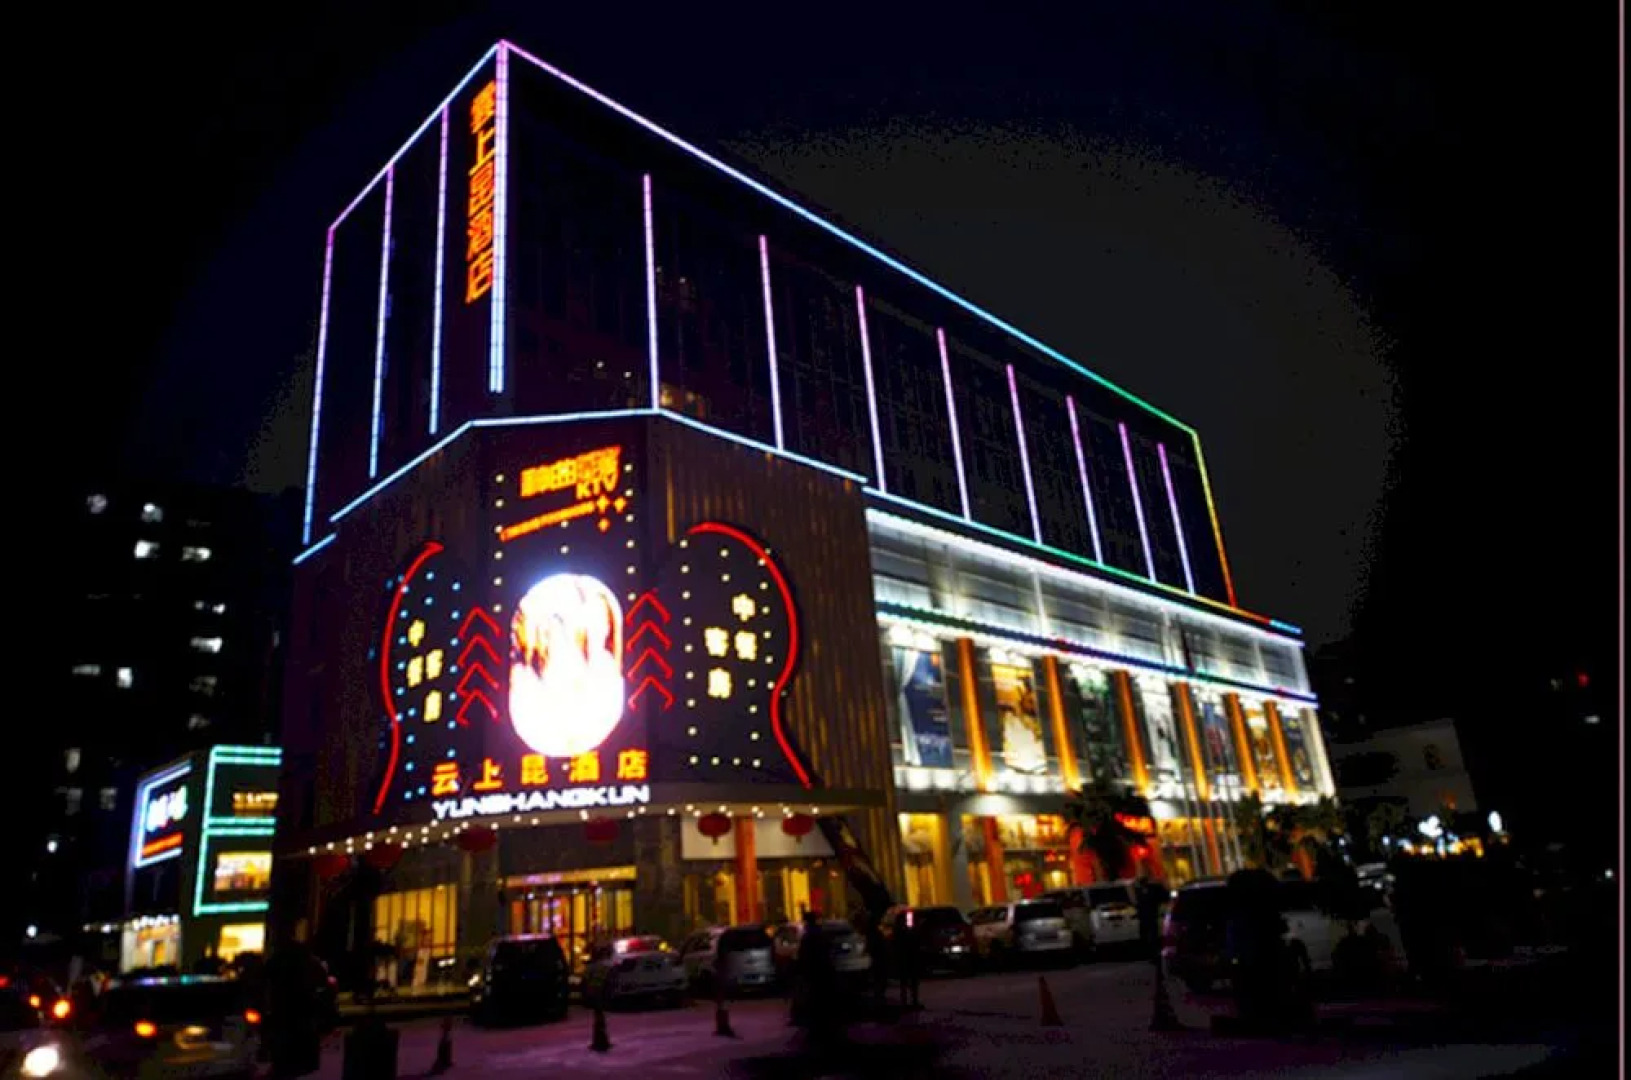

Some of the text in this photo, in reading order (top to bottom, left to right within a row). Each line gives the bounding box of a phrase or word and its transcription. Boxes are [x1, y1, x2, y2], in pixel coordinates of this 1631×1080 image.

[575, 472, 619, 499] KTV
[431, 749, 649, 796] 云上昆酒店
[431, 785, 650, 820] YUNSHANGKUN
